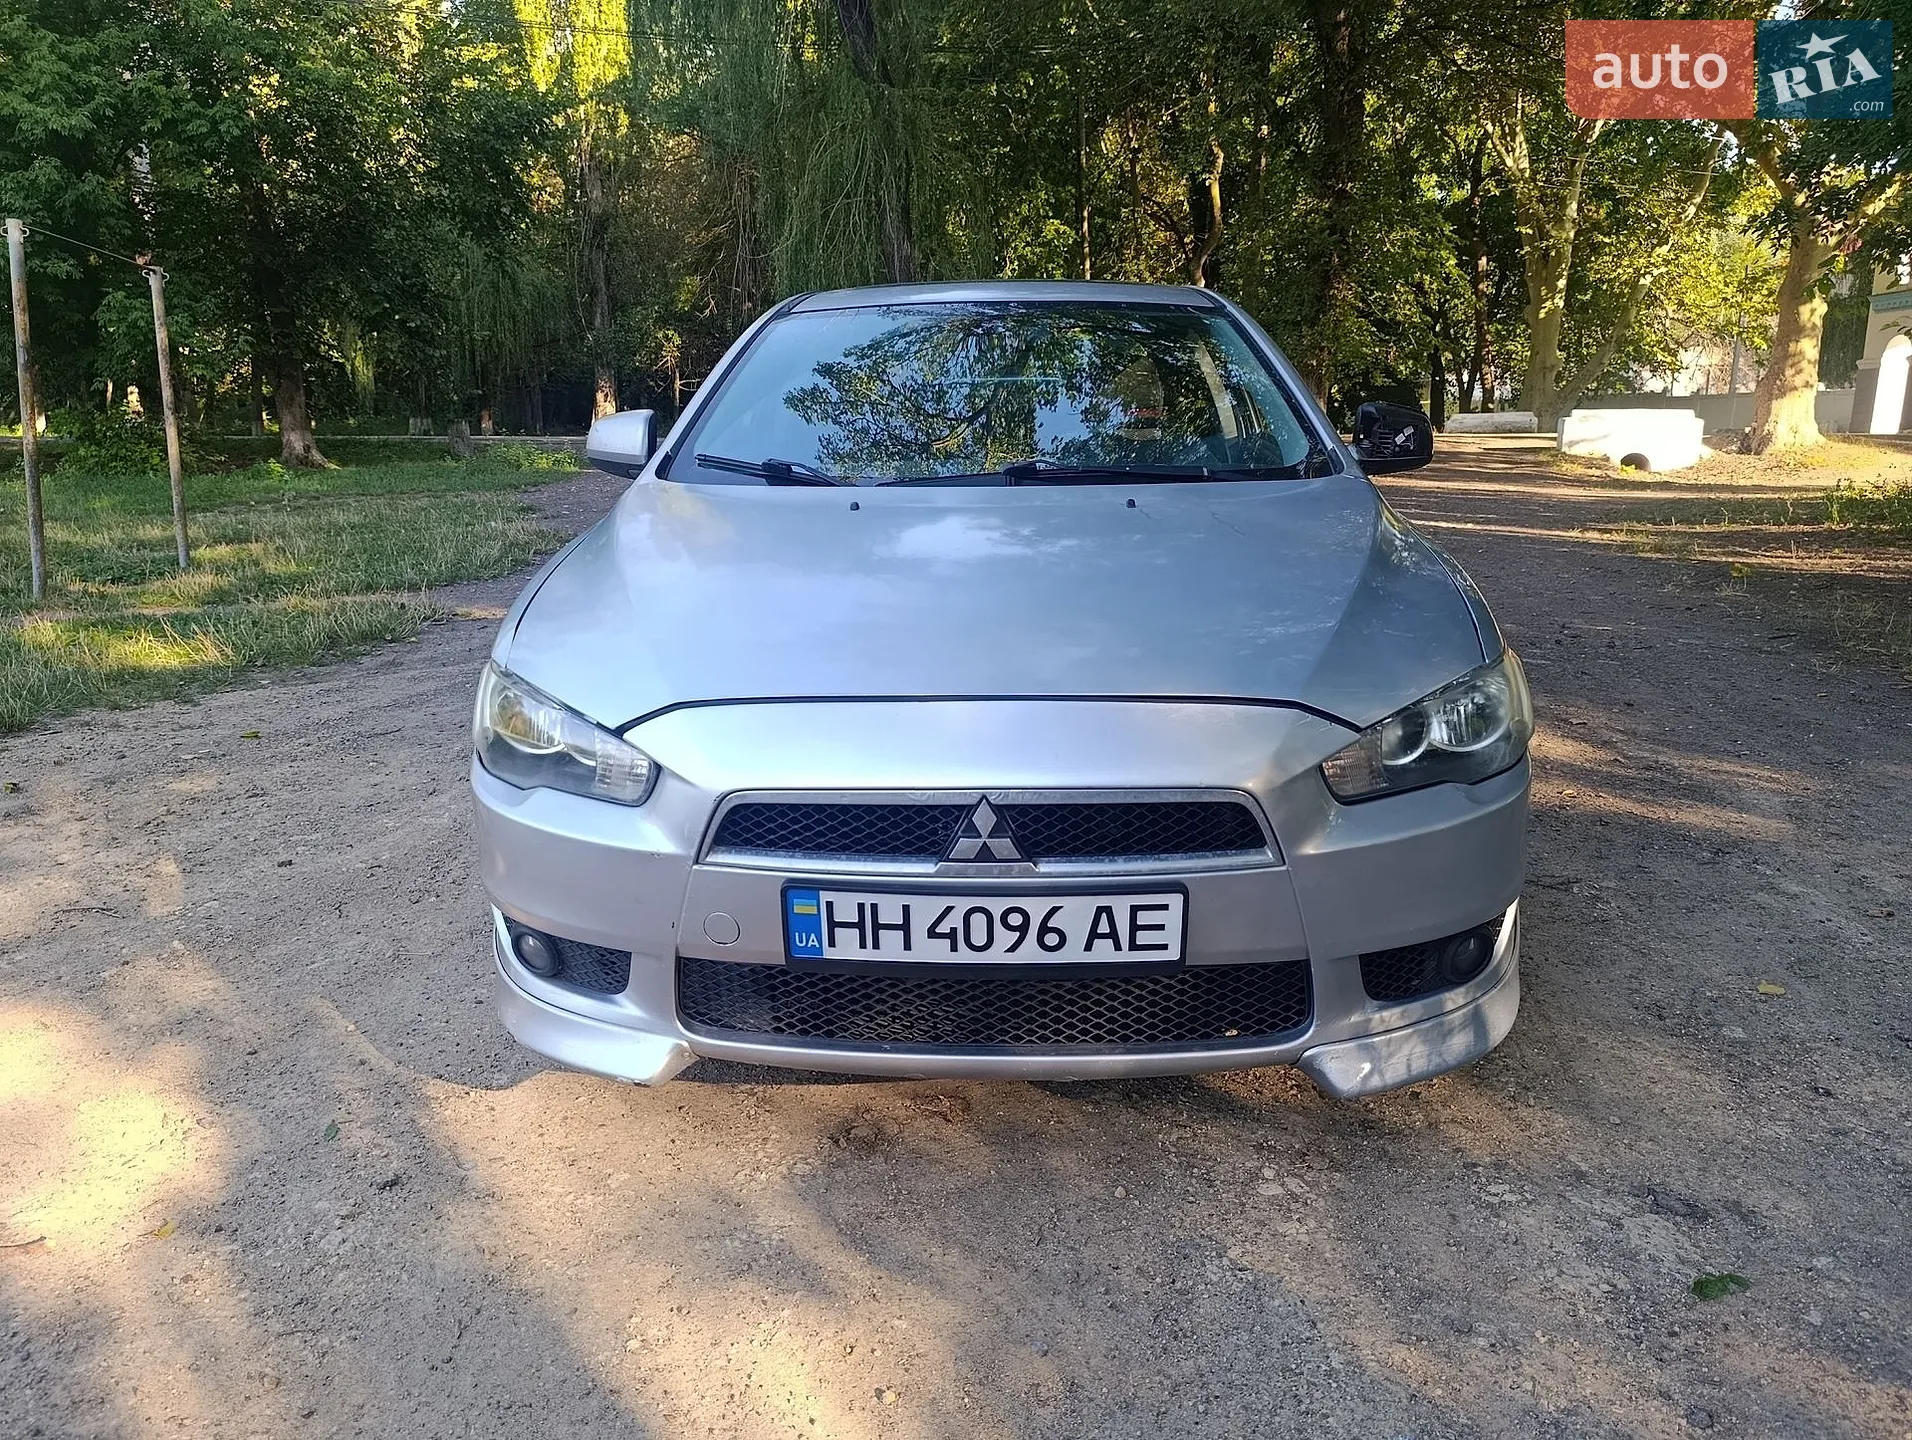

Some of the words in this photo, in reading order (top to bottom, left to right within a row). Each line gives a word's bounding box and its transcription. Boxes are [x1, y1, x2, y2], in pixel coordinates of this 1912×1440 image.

[795, 932, 820, 949] UA
[825, 900, 912, 952] HH
[926, 905, 1067, 953] 4096
[1083, 903, 1170, 952] AE
